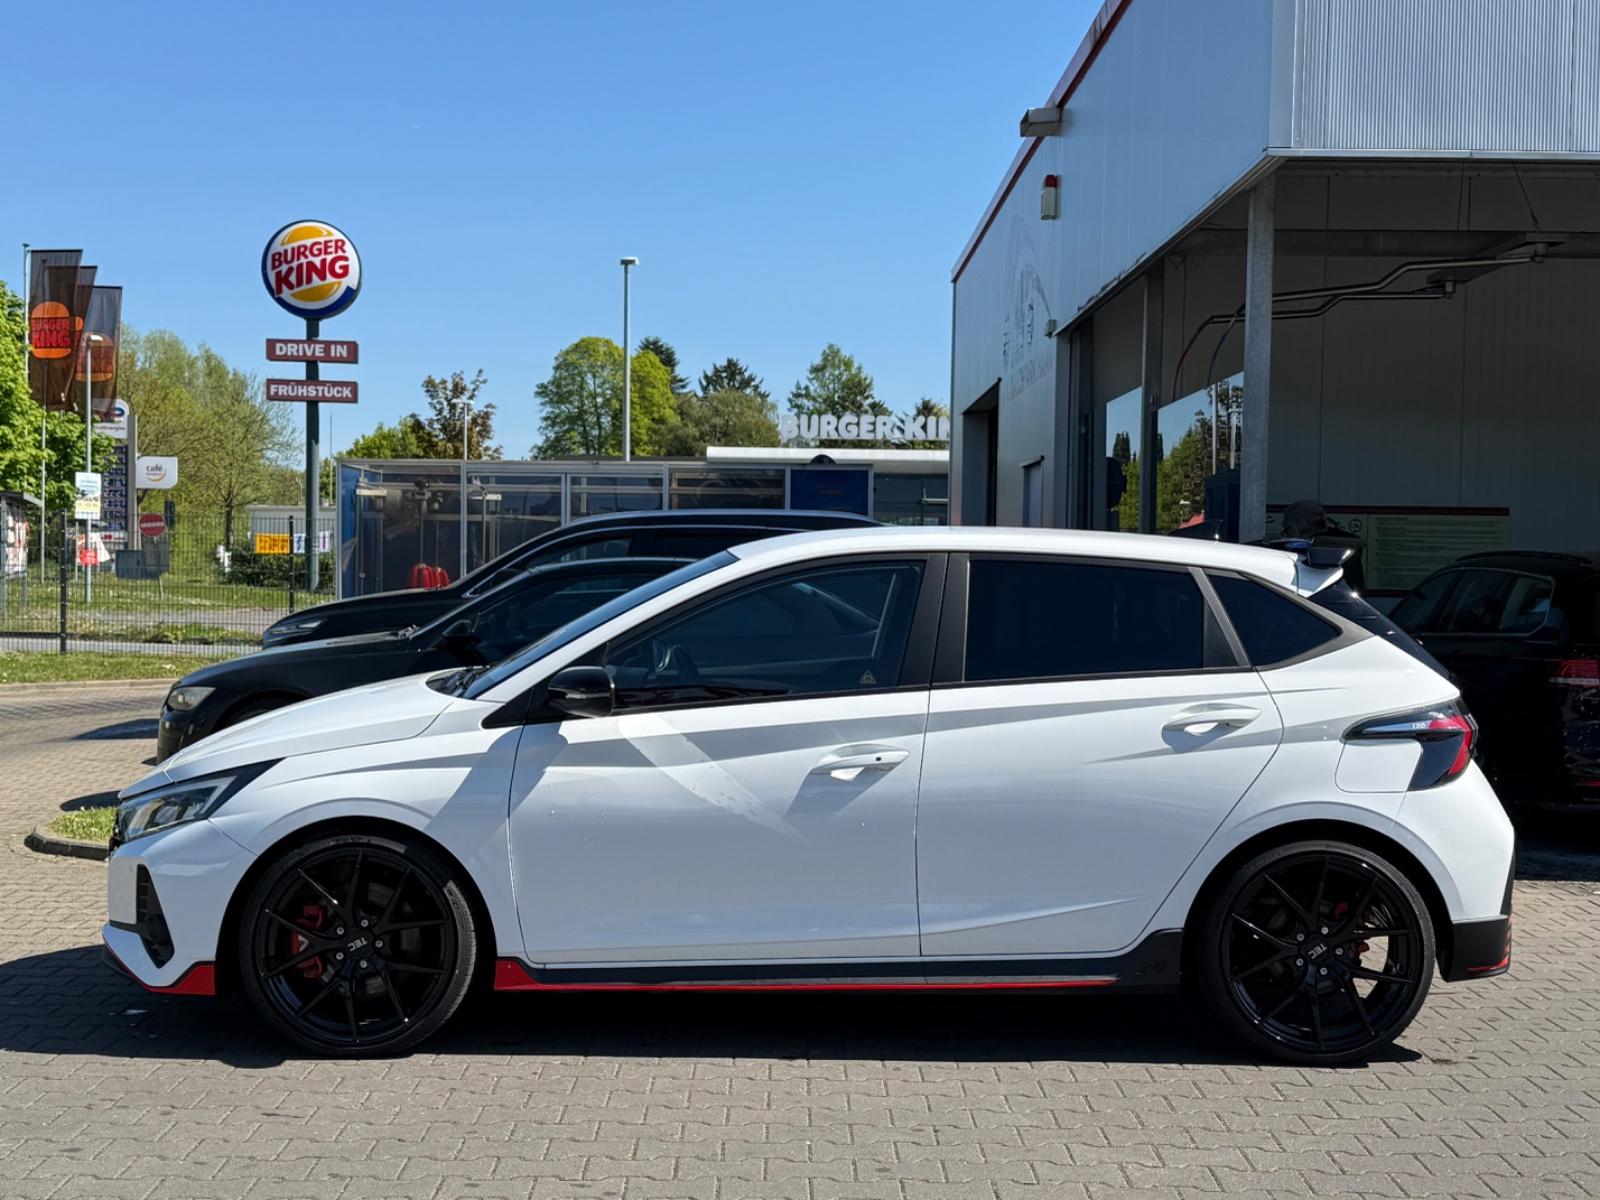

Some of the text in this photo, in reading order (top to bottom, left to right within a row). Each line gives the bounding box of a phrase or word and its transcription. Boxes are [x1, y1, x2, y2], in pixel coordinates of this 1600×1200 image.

[271, 239, 347, 271] BURGER
[274, 255, 350, 297] KING
[31, 317, 70, 331] BURGER
[32, 330, 71, 347] KING
[275, 343, 347, 358] DRIVE IN
[270, 382, 352, 398] FRÜHSTÜCK
[781, 414, 896, 440] BURGER
[145, 463, 163, 471] café
[347, 936, 368, 951] TEC
